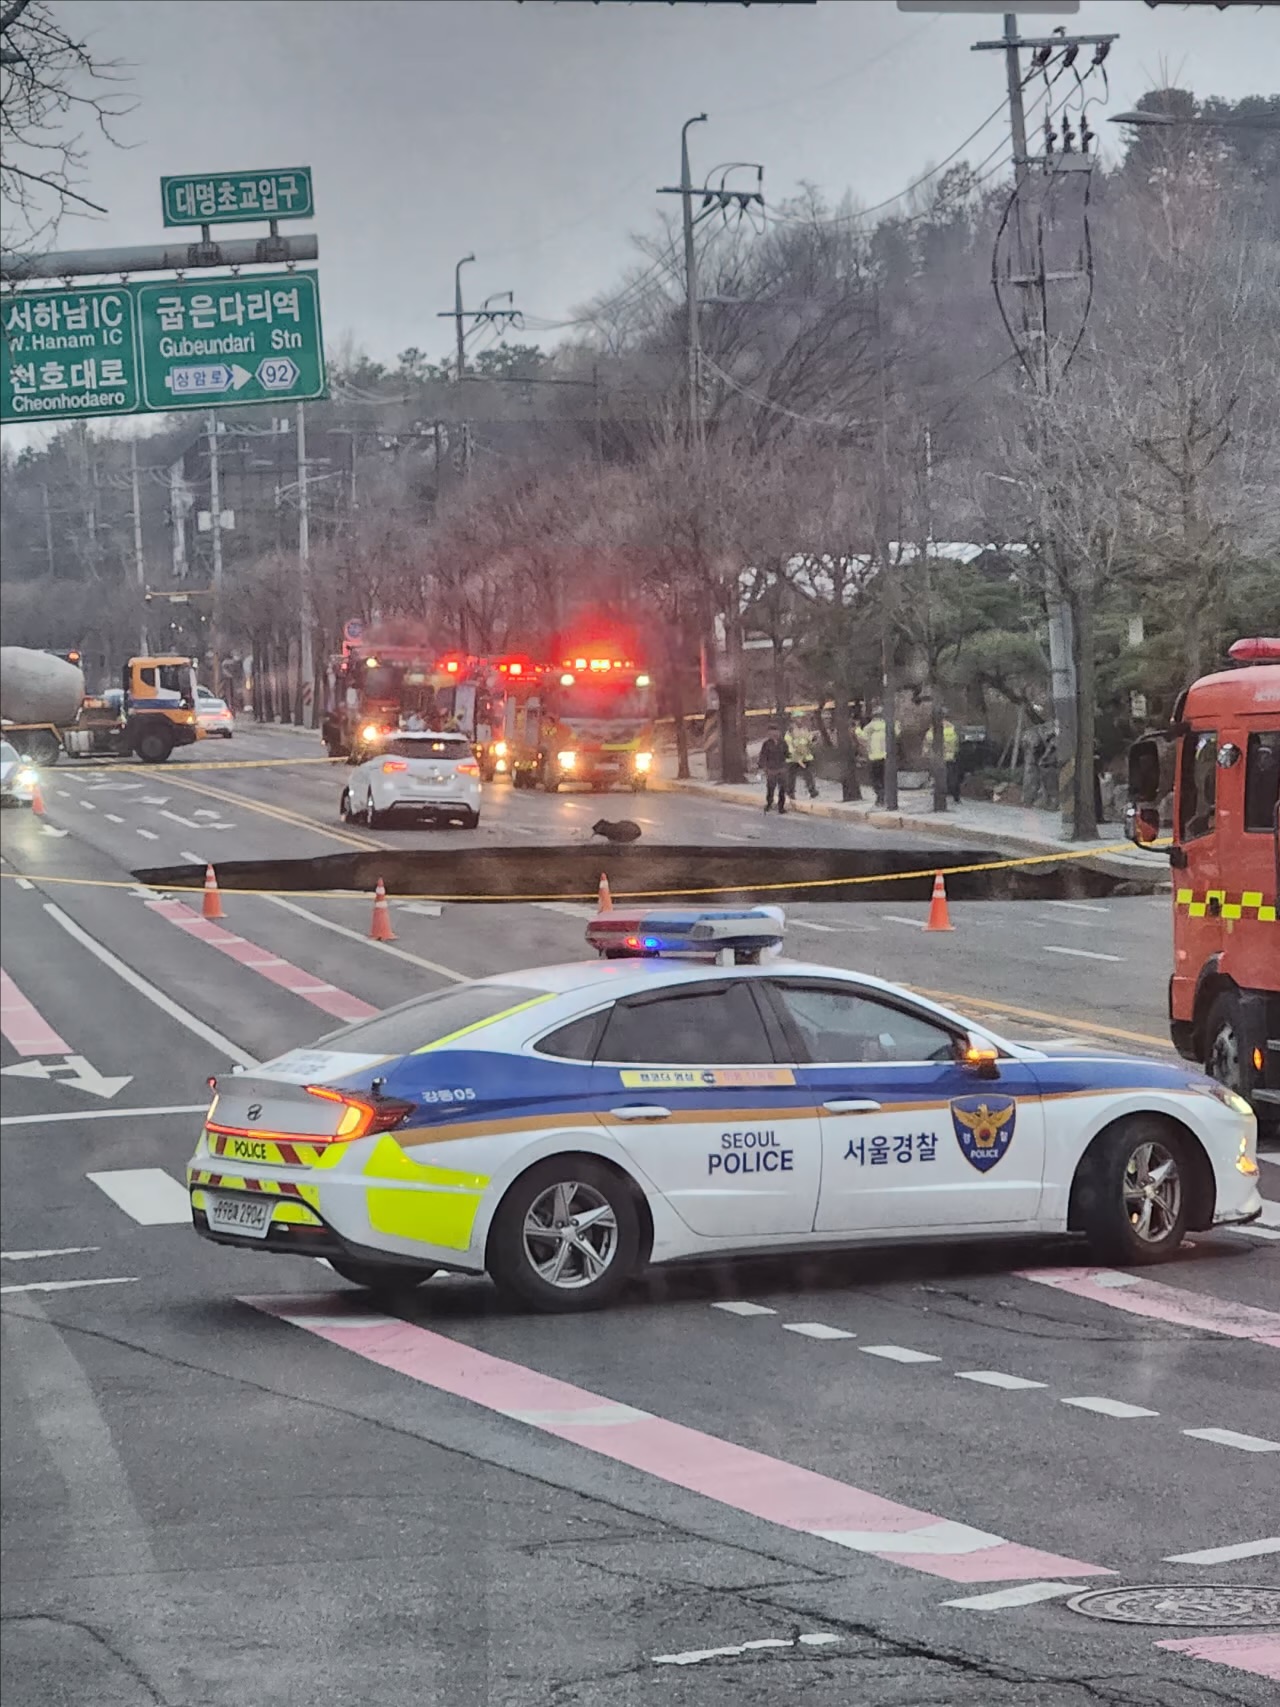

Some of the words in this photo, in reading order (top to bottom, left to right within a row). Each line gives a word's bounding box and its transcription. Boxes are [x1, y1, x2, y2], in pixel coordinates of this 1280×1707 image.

[175, 176, 299, 217] 대명초교입구
[5, 295, 123, 333] 서하남IC
[156, 288, 301, 331] 굽은다리역
[102, 328, 123, 345] IC
[159, 332, 255, 358] Gubeundari
[271, 329, 302, 350] Stn
[10, 358, 128, 394] 천호대로
[265, 364, 289, 383] 92
[12, 390, 125, 413] Cheonhodaero
[234, 1139, 267, 1160] POLICE
[721, 1130, 781, 1150] SEOUL
[843, 1132, 939, 1167] 서울경찰
[708, 1149, 794, 1176] POLICE
[970, 1149, 999, 1159] POLICE
